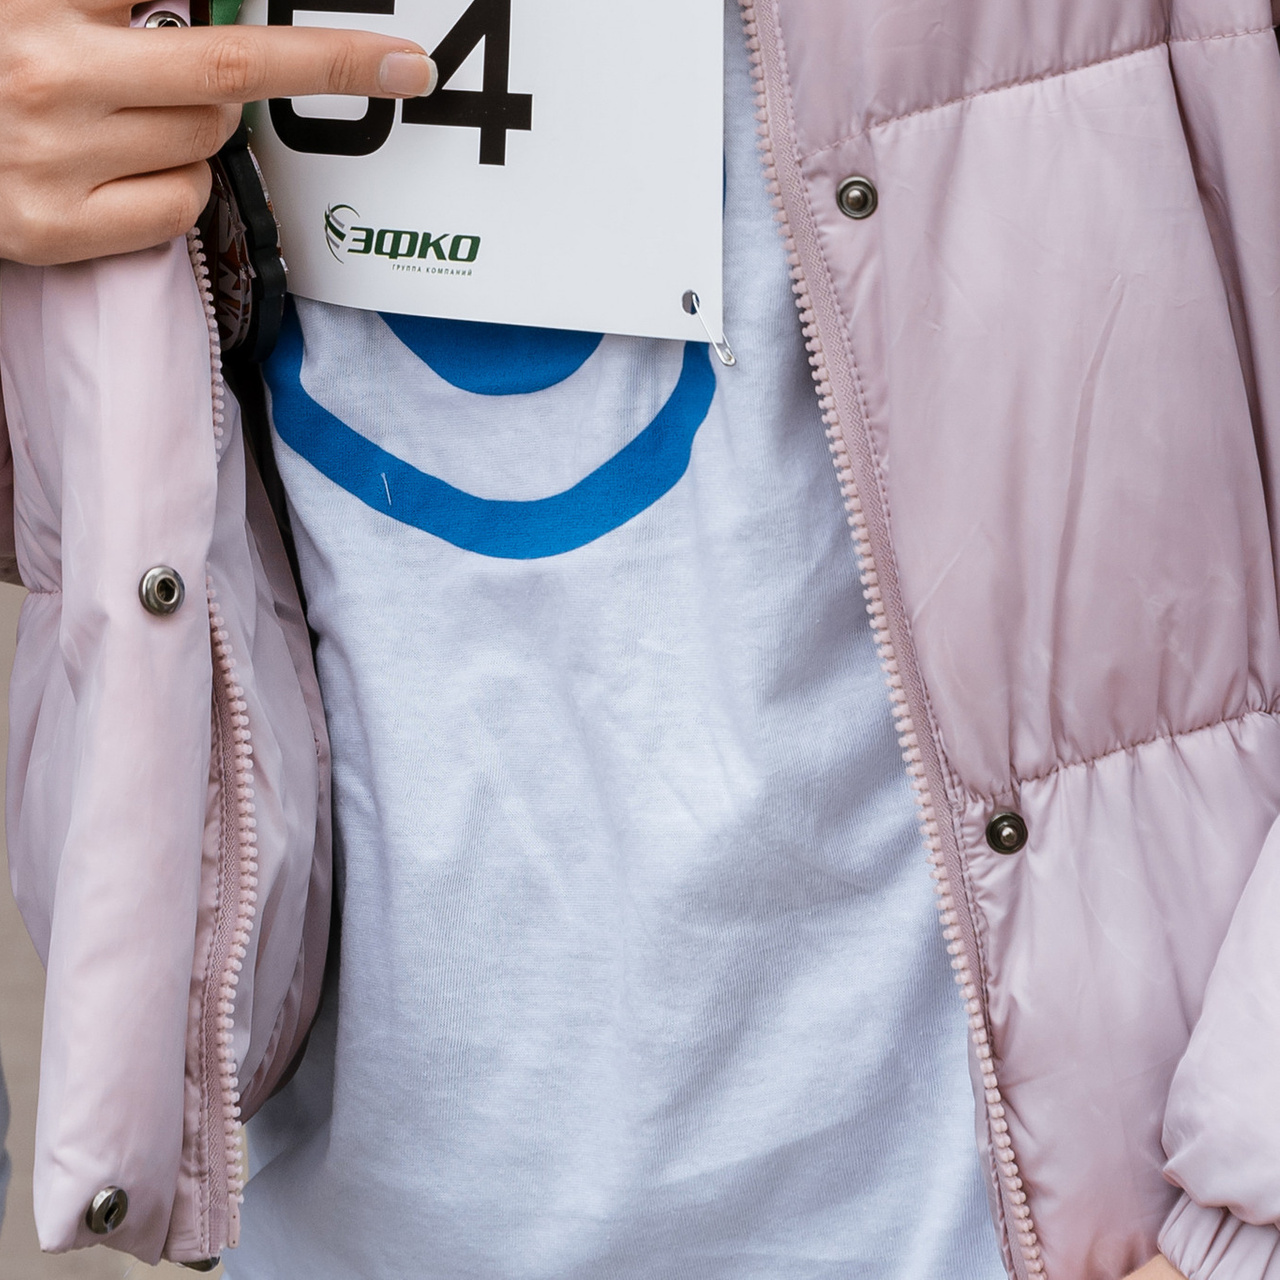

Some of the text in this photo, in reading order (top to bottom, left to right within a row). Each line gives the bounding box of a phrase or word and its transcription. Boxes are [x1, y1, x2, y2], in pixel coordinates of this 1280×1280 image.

[347, 226, 481, 262] ЭФКО
[391, 263, 473, 277] ГРУППА КОМПАНИЙ
